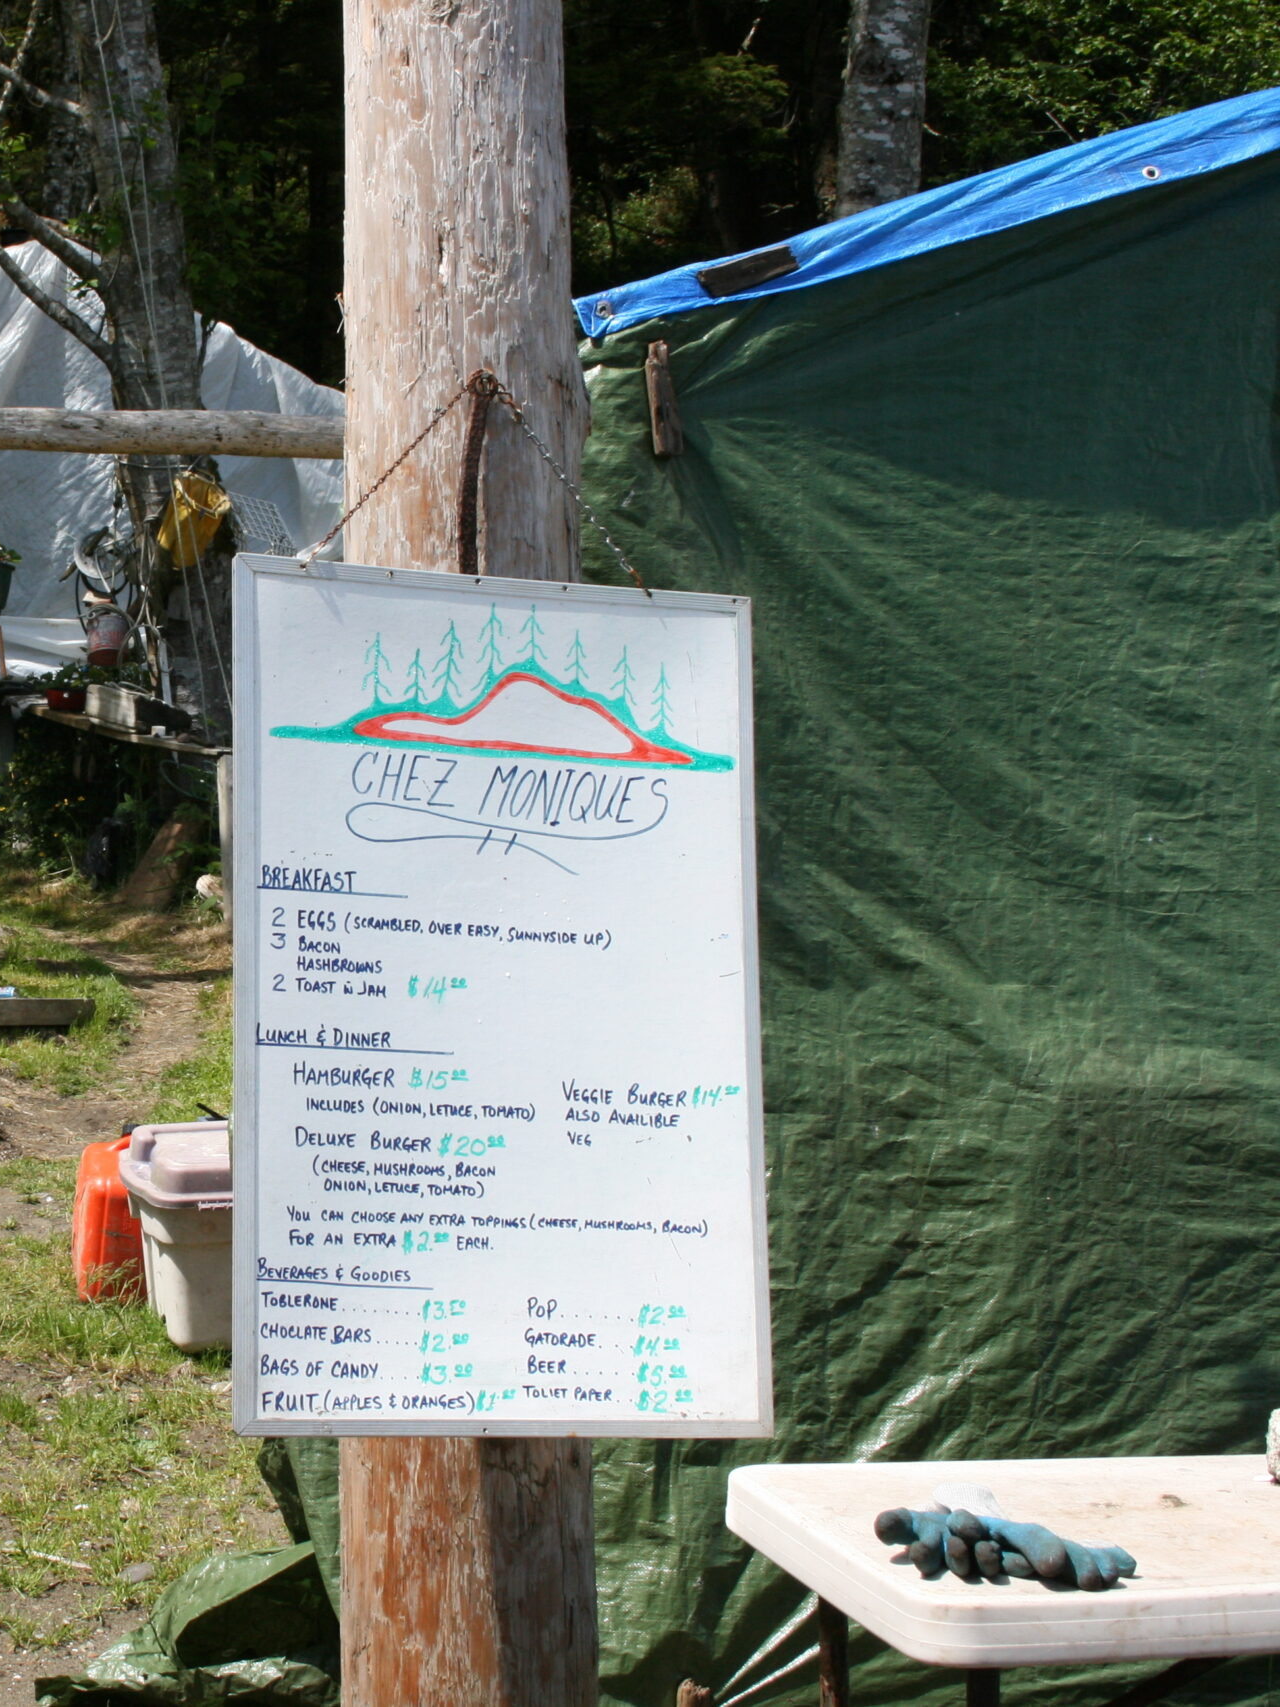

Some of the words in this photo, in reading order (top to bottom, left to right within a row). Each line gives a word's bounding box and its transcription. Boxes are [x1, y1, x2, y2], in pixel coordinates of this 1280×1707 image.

[352, 752, 457, 807] CHEZ
[478, 766, 669, 827] MONIQUES
[262, 865, 356, 892] BREAKFAST
[272, 907, 286, 927] 2
[297, 910, 336, 932] EGGS
[429, 922, 462, 936] OVER
[507, 928, 577, 945] SUNNYSIDE
[584, 929, 611, 950] UP)
[270, 933, 286, 949] 3
[298, 935, 340, 954] BACON
[297, 956, 382, 973] HASHBROWNS
[273, 974, 286, 991] 2
[296, 977, 336, 993] TOAST
[357, 981, 386, 998] JAM
[256, 1023, 307, 1044] LUNCH
[317, 1024, 326, 1045] &
[334, 1028, 390, 1048] DINNER
[293, 1061, 395, 1089] HAMBURGER
[562, 1078, 613, 1105] VEGGIE
[627, 1083, 687, 1108] BURGER
[306, 1097, 365, 1113] INCLUDES
[373, 1097, 426, 1118] (ONION,
[481, 1103, 535, 1122] TOMATO)
[565, 1108, 599, 1123] ALSO
[608, 1109, 680, 1128] AVAILIBLE
[295, 1126, 356, 1148] DELUXE
[370, 1131, 431, 1153] BURGER
[567, 1131, 591, 1146] VEG
[455, 1162, 495, 1177] BACON
[427, 1181, 485, 1198] TOMATO)
[287, 1206, 310, 1222] YOU
[321, 1210, 343, 1221] CAN
[351, 1211, 396, 1224] CHOOSE
[400, 1212, 423, 1224] ANY
[429, 1214, 465, 1226] EXTRA
[471, 1216, 526, 1229] TOPPINGS
[662, 1219, 708, 1238] BACON)
[289, 1229, 314, 1246] FOR
[324, 1232, 343, 1245] AN
[354, 1232, 396, 1246] EXTRA
[457, 1235, 494, 1250] EACH.
[258, 1257, 328, 1279] BEVERAGES
[336, 1264, 343, 1281] &
[351, 1266, 411, 1282] GOODIES
[260, 1323, 327, 1340] CHOCLATE
[260, 1354, 299, 1376] BAGS
[306, 1361, 324, 1376] OF
[261, 1391, 319, 1412] FRUIT
[389, 1395, 397, 1409] &
[402, 1391, 476, 1415] ORANGES)
[522, 1385, 568, 1398] TOLIET
